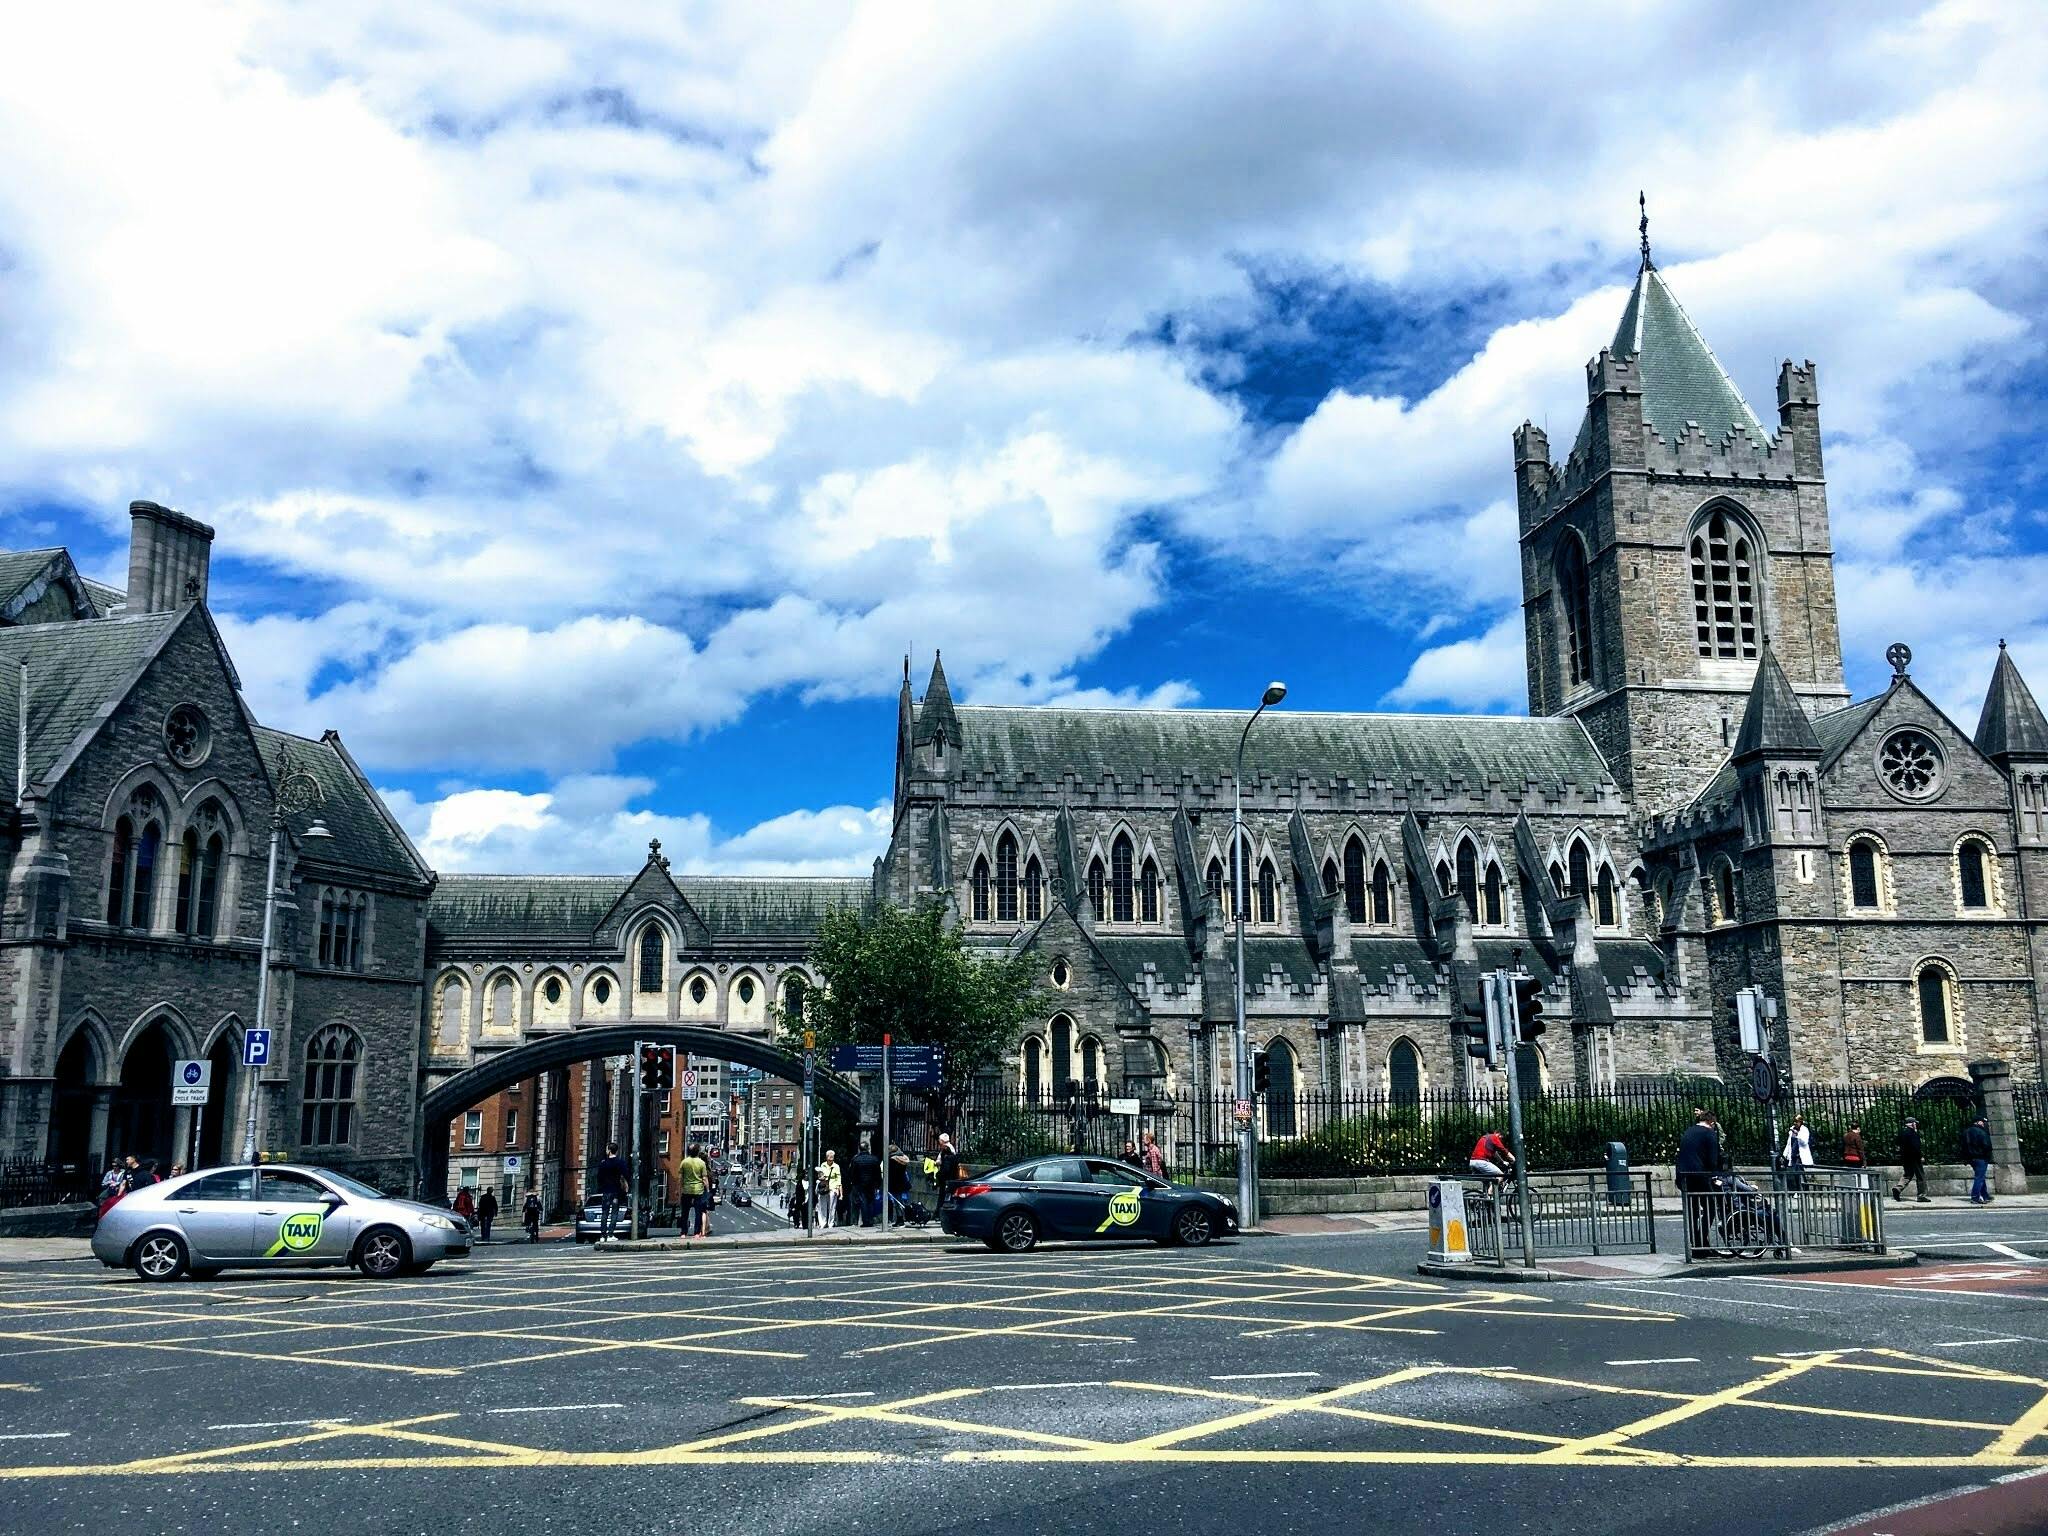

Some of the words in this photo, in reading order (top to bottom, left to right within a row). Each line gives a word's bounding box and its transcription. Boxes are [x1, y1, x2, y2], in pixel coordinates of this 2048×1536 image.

[249, 1042, 265, 1063] P
[1755, 1069, 1768, 1088] 30
[1113, 1203, 1136, 1214] TAXI
[286, 1223, 317, 1238] TAXI
